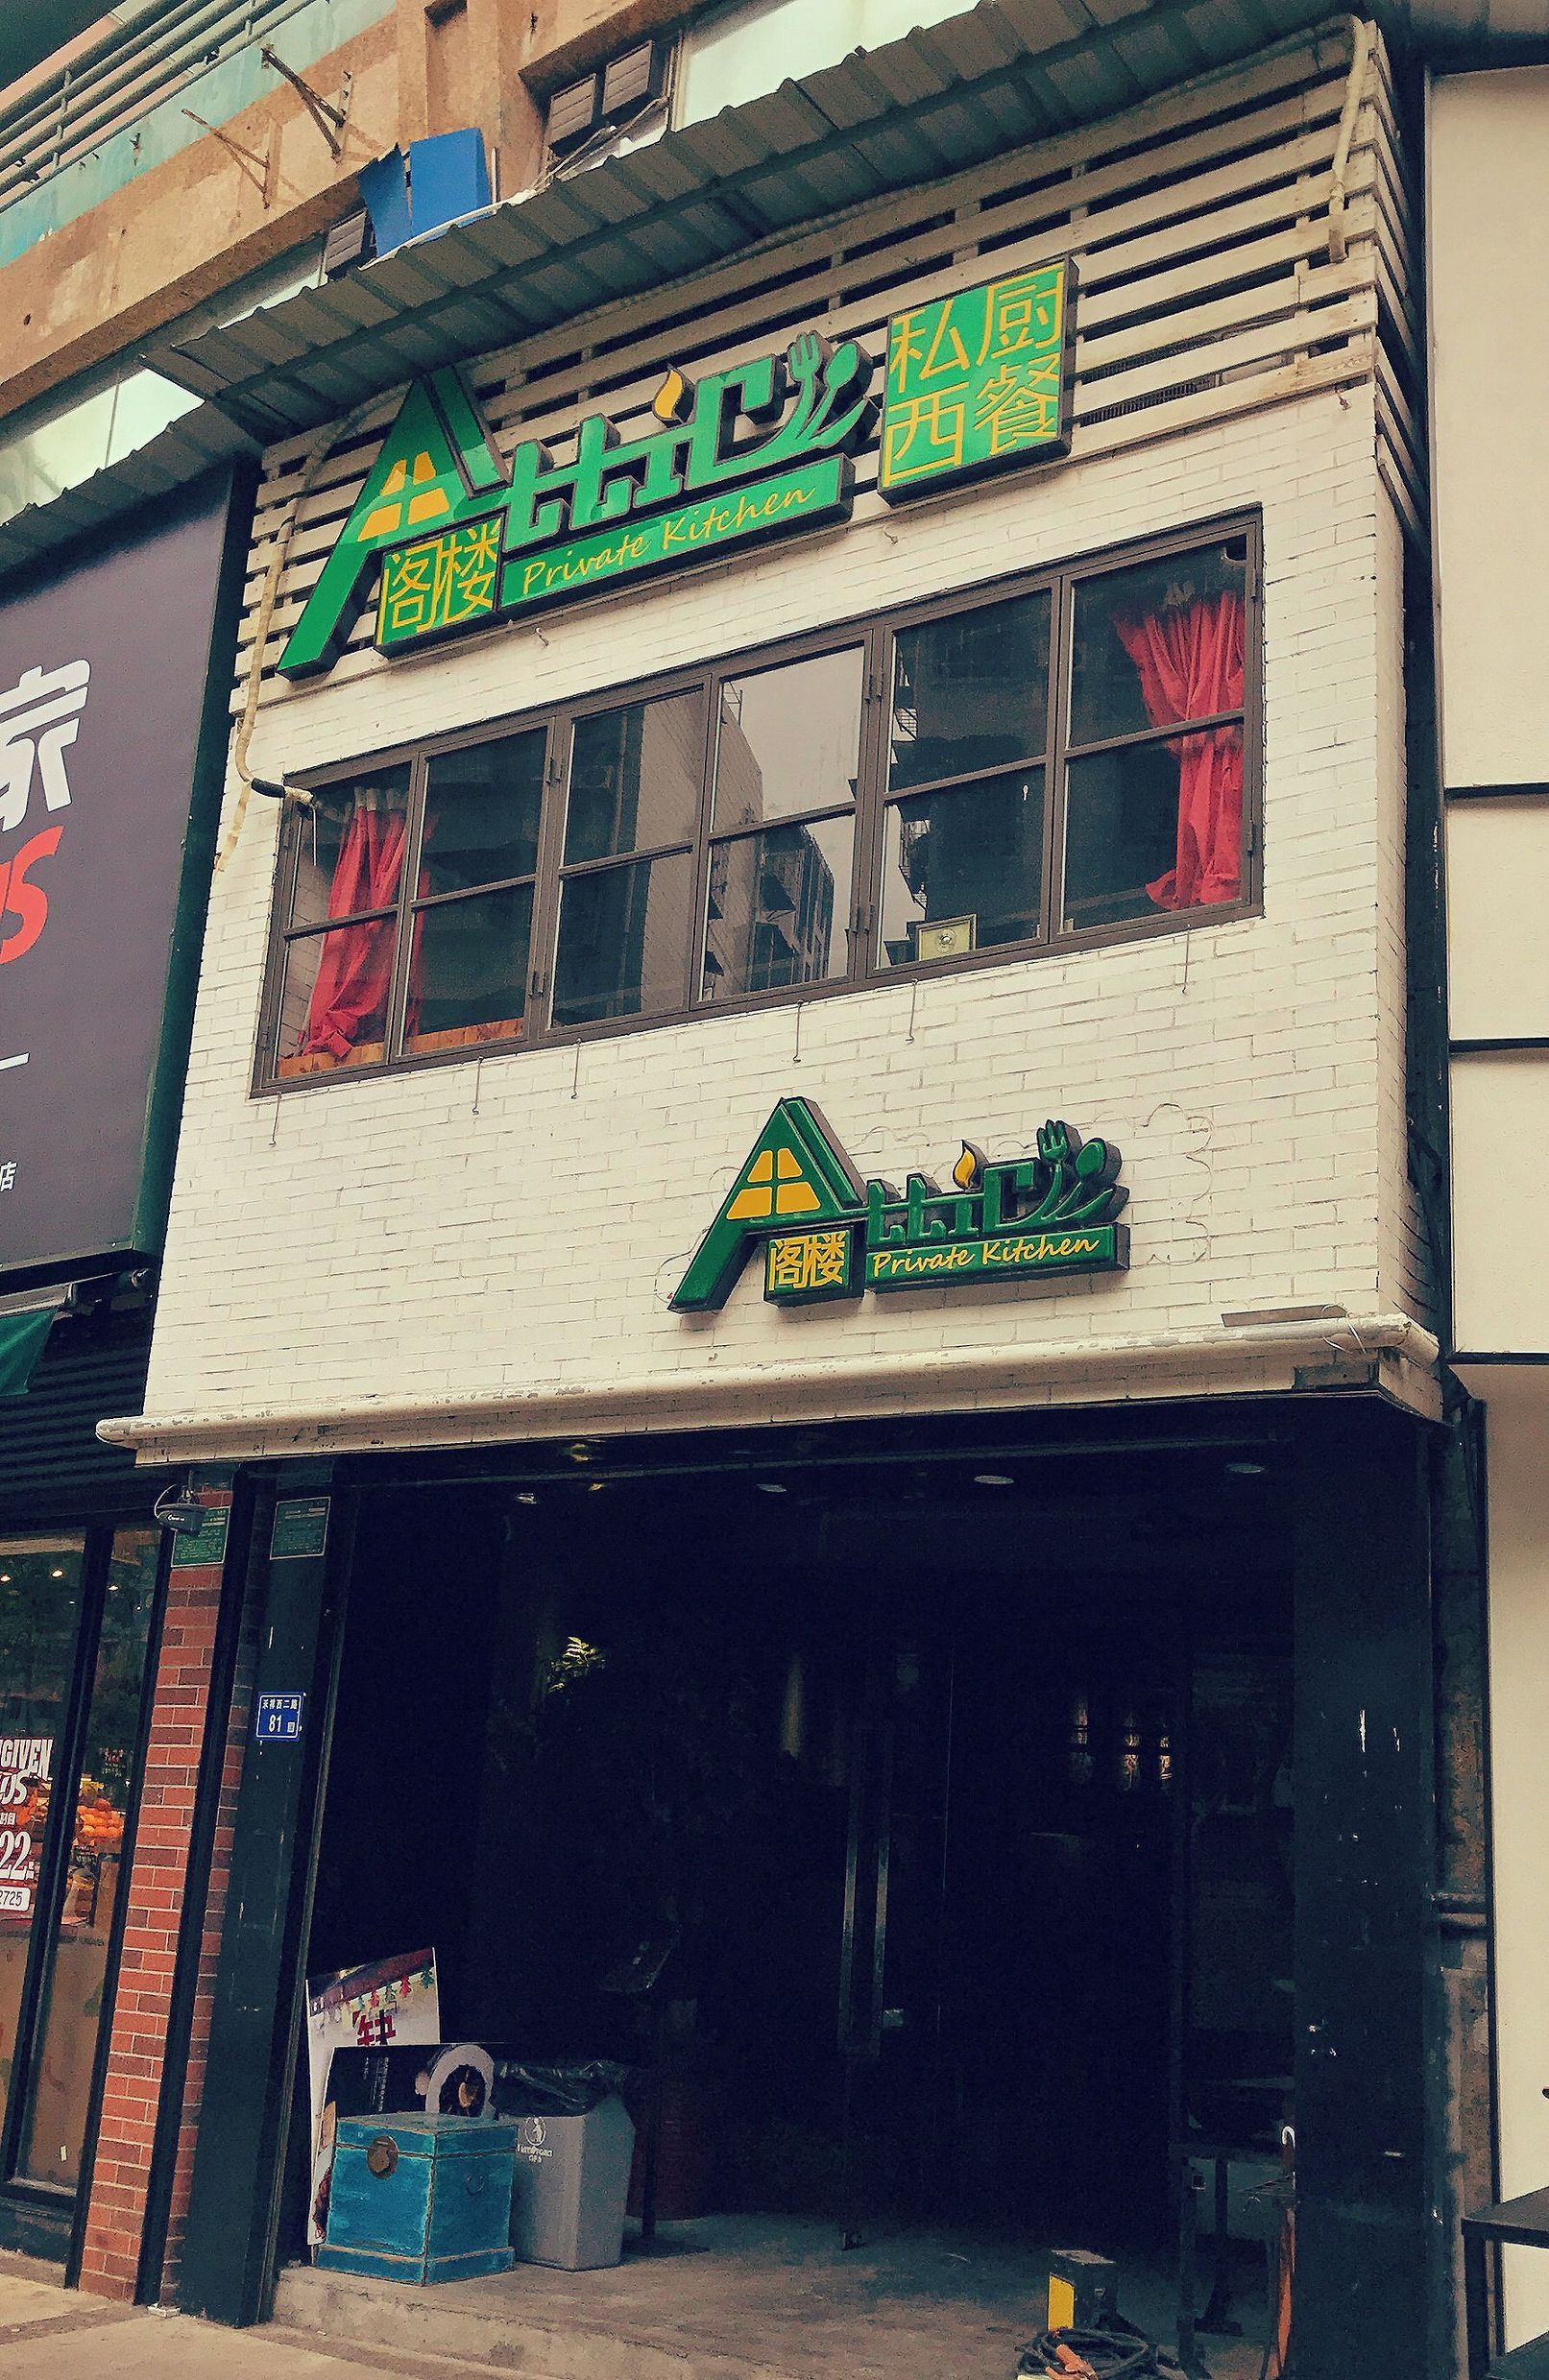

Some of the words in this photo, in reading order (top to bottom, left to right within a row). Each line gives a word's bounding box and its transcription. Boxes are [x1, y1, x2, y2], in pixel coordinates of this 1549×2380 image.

[889, 261, 1066, 394] 私厨
[882, 351, 1060, 488] 西餐
[377, 517, 501, 645] 阁楼
[521, 531, 653, 594] Private
[662, 485, 816, 550] Kitchen
[0, 824, 64, 963] S
[767, 1229, 848, 1292] 阁楼
[872, 1247, 980, 1278] Private
[981, 1233, 1101, 1267] Kitchen
[0, 1739, 53, 1781] GIVEN
[269, 1714, 282, 1733] 81
